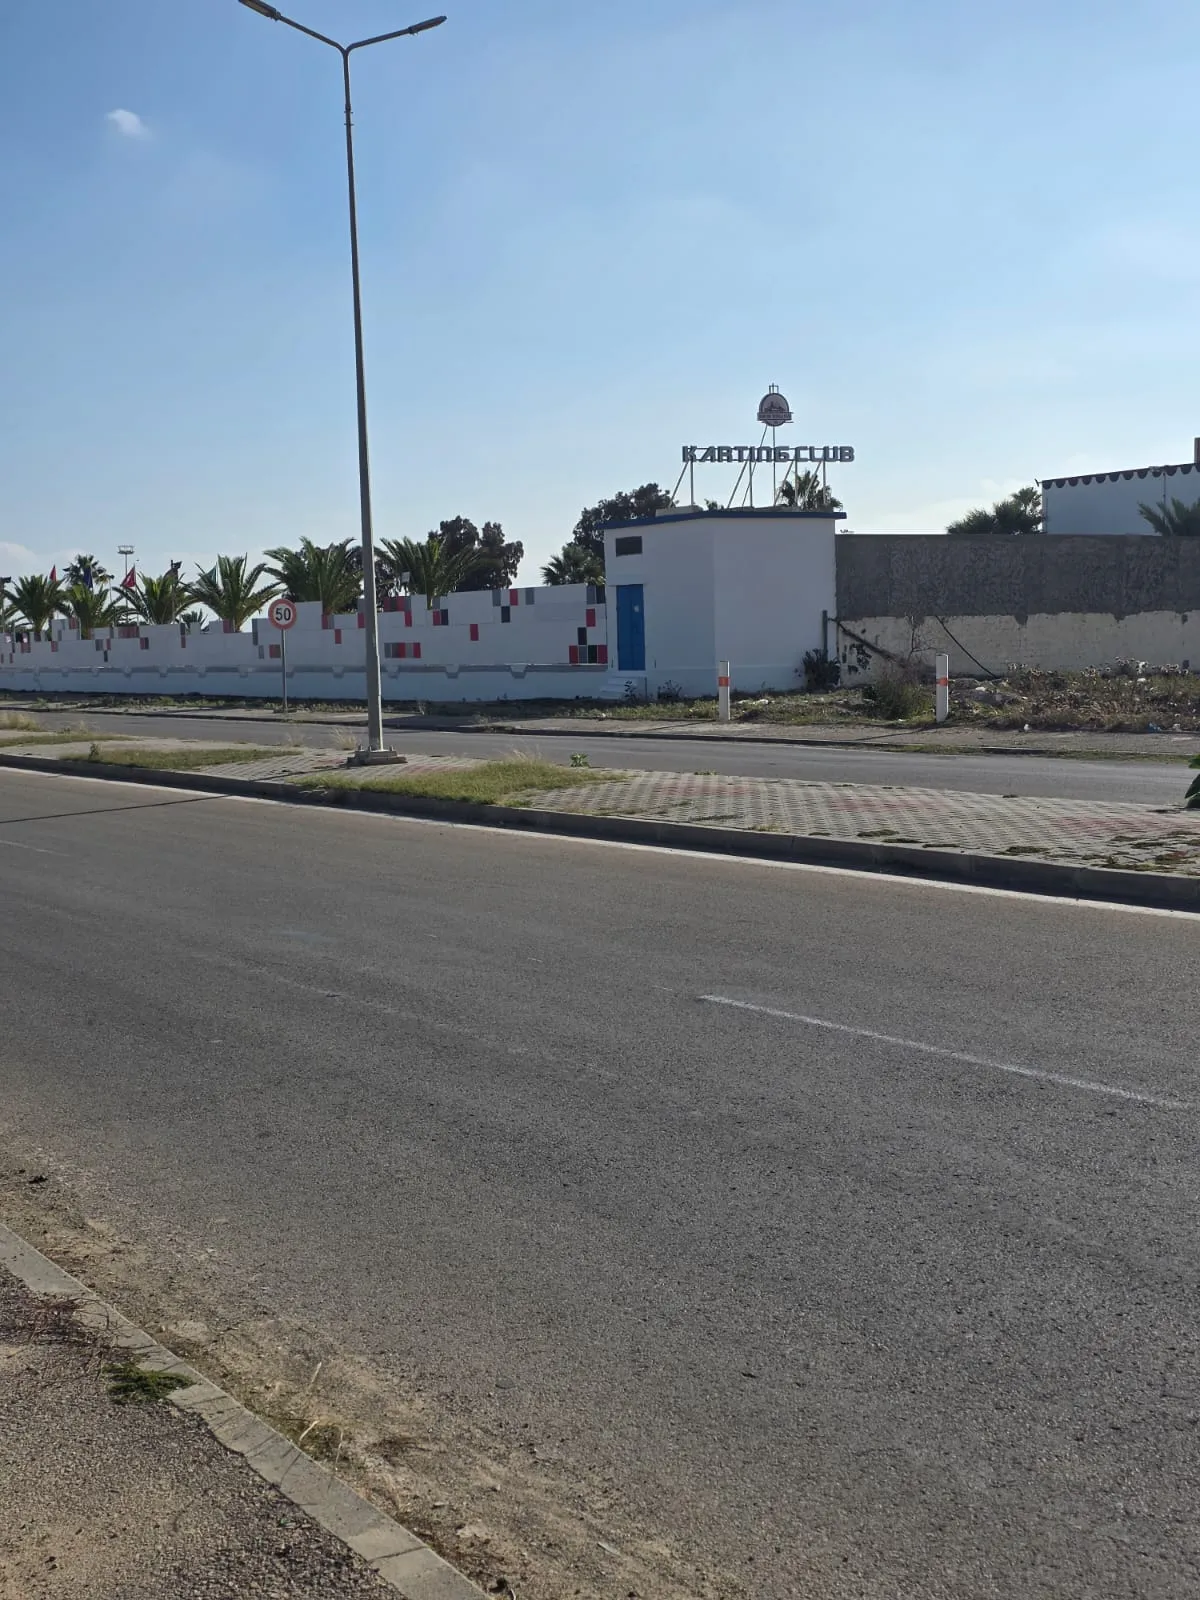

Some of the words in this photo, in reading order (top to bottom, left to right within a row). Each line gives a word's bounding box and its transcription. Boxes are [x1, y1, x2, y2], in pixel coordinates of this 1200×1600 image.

[682, 445, 790, 462] KARTING
[794, 445, 855, 462] CLUB
[275, 607, 291, 621] 50
